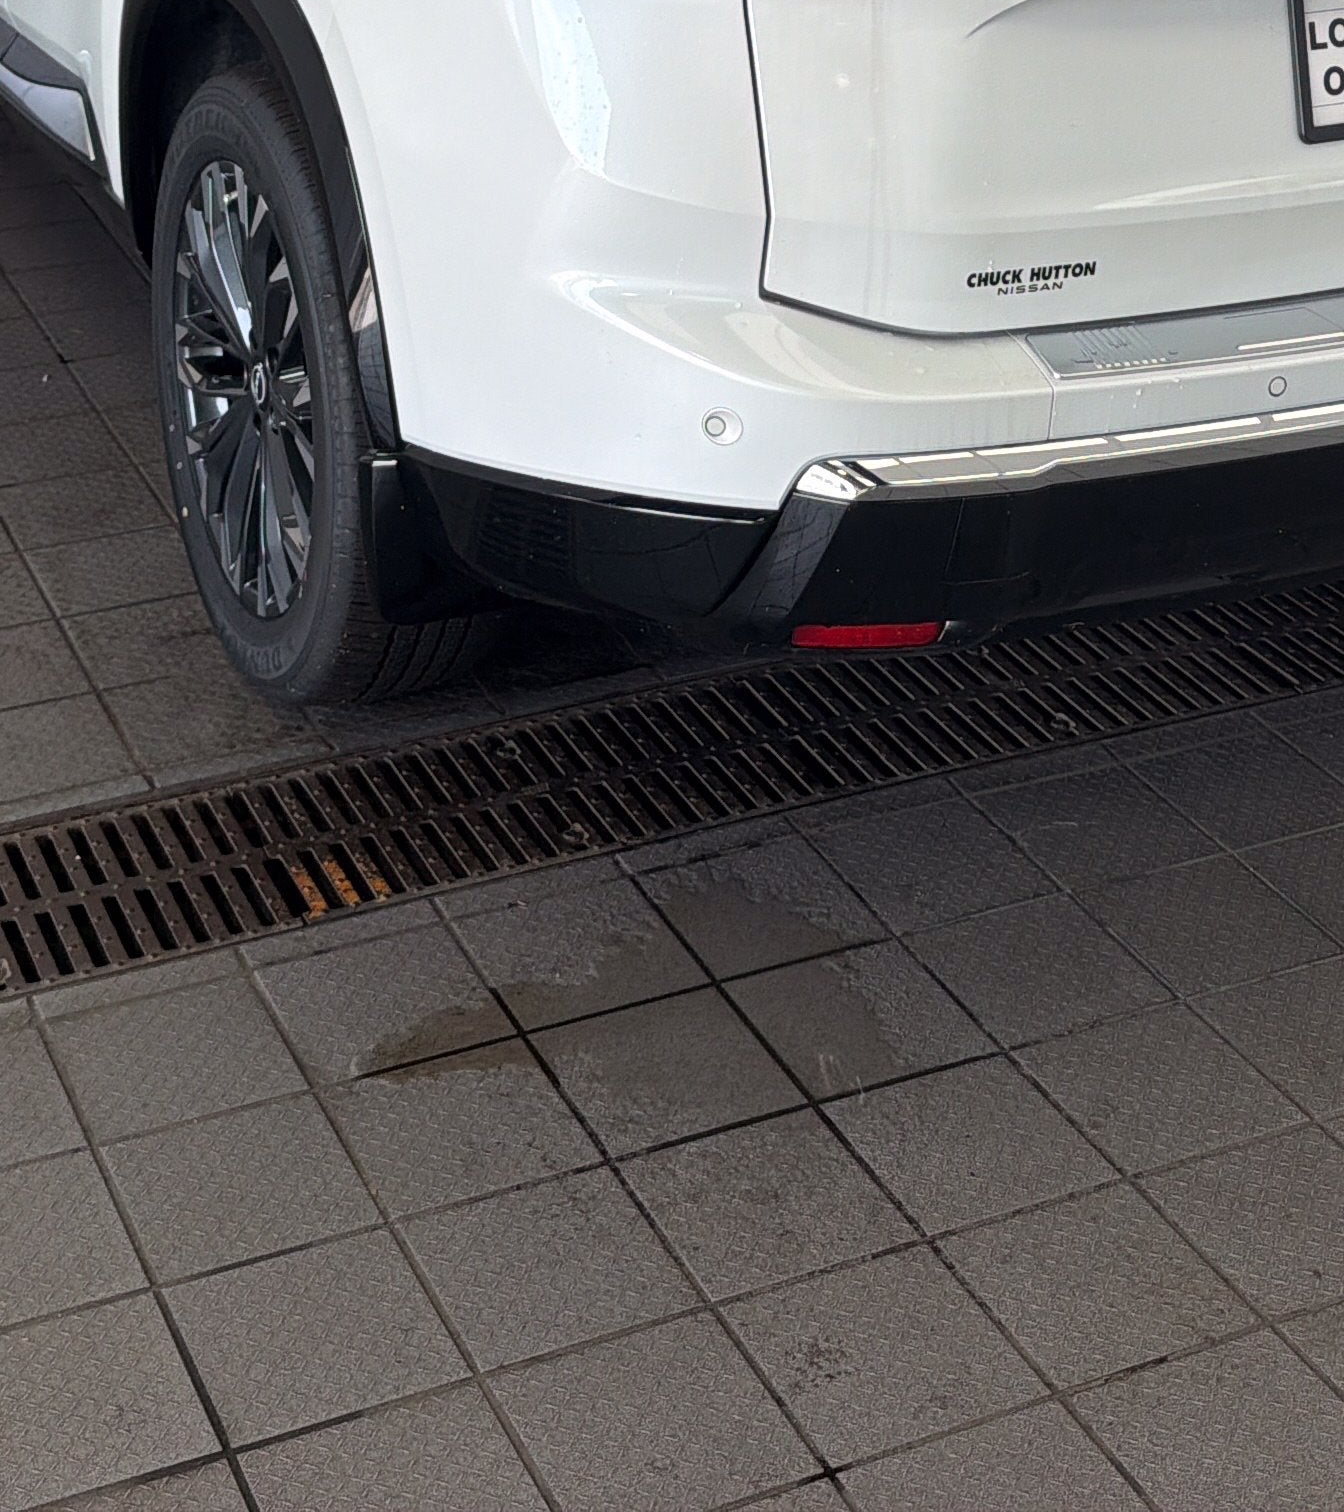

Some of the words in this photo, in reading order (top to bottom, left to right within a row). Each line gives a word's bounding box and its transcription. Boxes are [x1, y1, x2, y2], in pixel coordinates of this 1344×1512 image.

[966, 268, 1024, 288] CHUCK
[1029, 261, 1097, 283] HUTTON
[997, 281, 1064, 296] NISSAN
